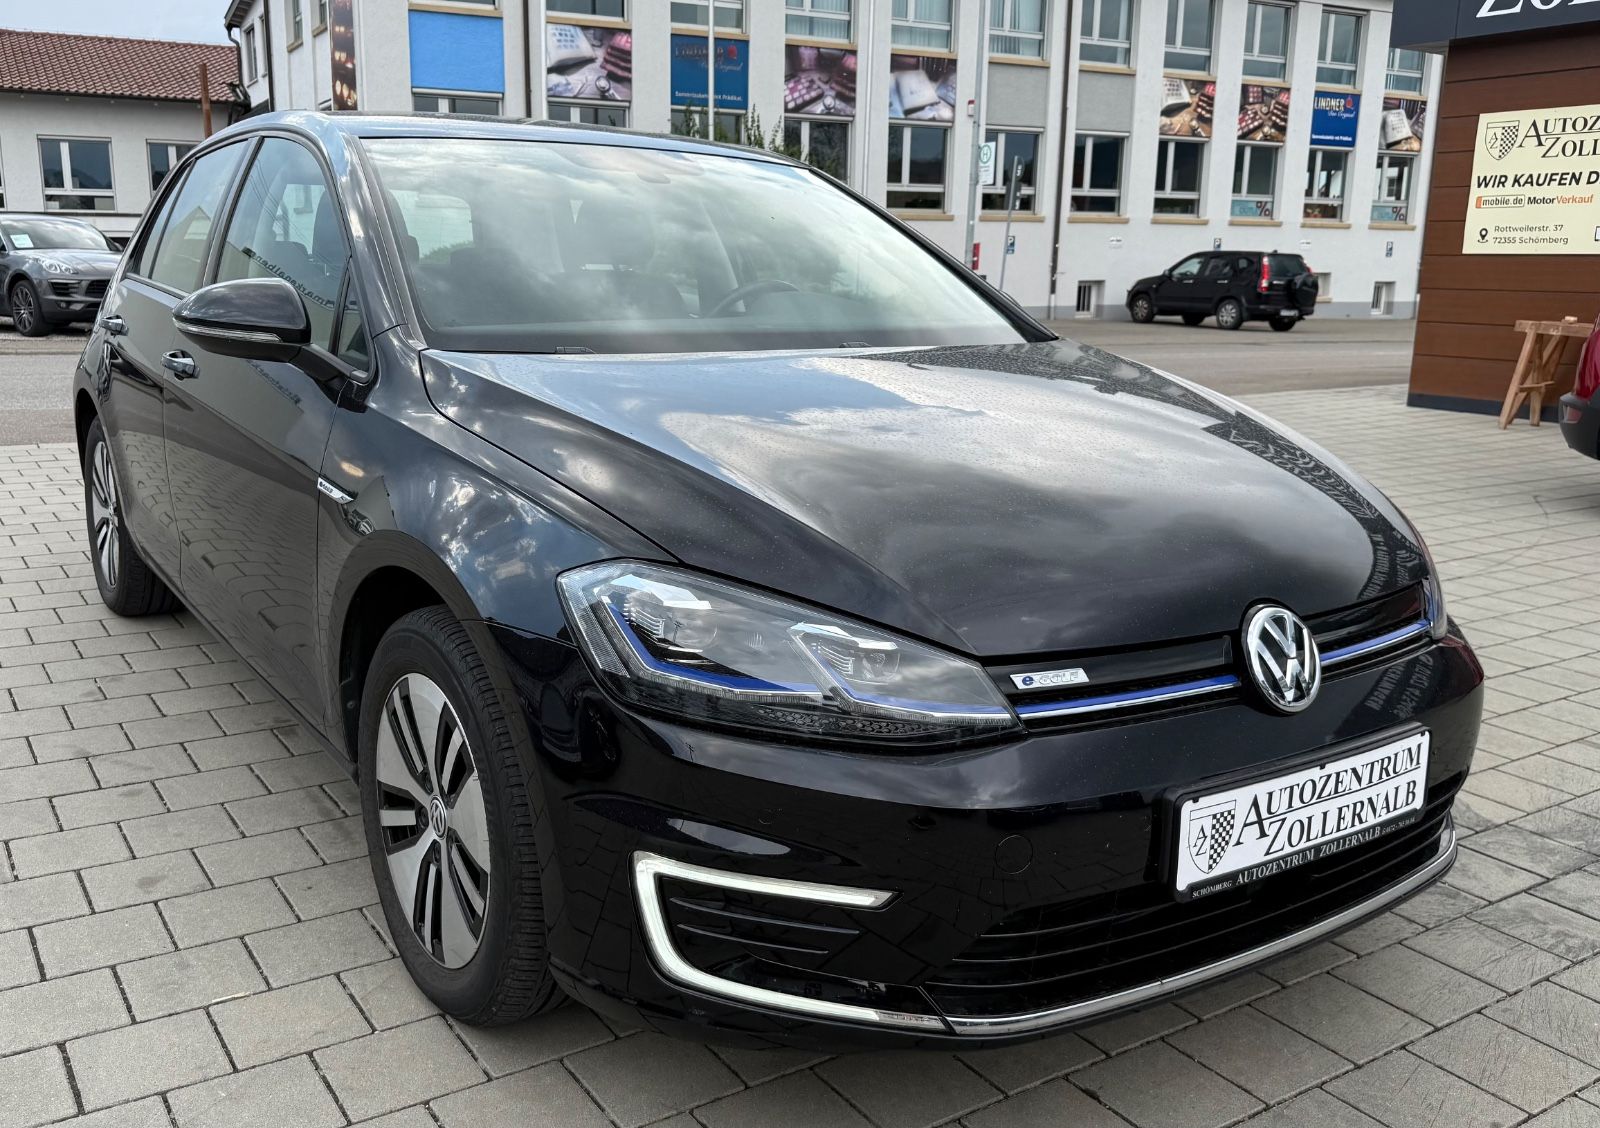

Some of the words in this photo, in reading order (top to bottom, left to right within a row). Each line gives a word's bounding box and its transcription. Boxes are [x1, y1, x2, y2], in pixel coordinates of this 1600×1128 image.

[1314, 97, 1345, 112] LINDNER
[1476, 175, 1508, 188] WIR
[1511, 171, 1583, 188] KAUFEN
[1482, 196, 1524, 206] mobile.de
[1553, 224, 1564, 232] 37
[1493, 236, 1517, 245] 72355
[1232, 743, 1423, 847] AUTOZENTRUM
[1264, 779, 1418, 857] ZOLLERNALB
[1236, 850, 1314, 886] AUTOZENTRUM
[1320, 826, 1381, 857] ZOLLERNALB
